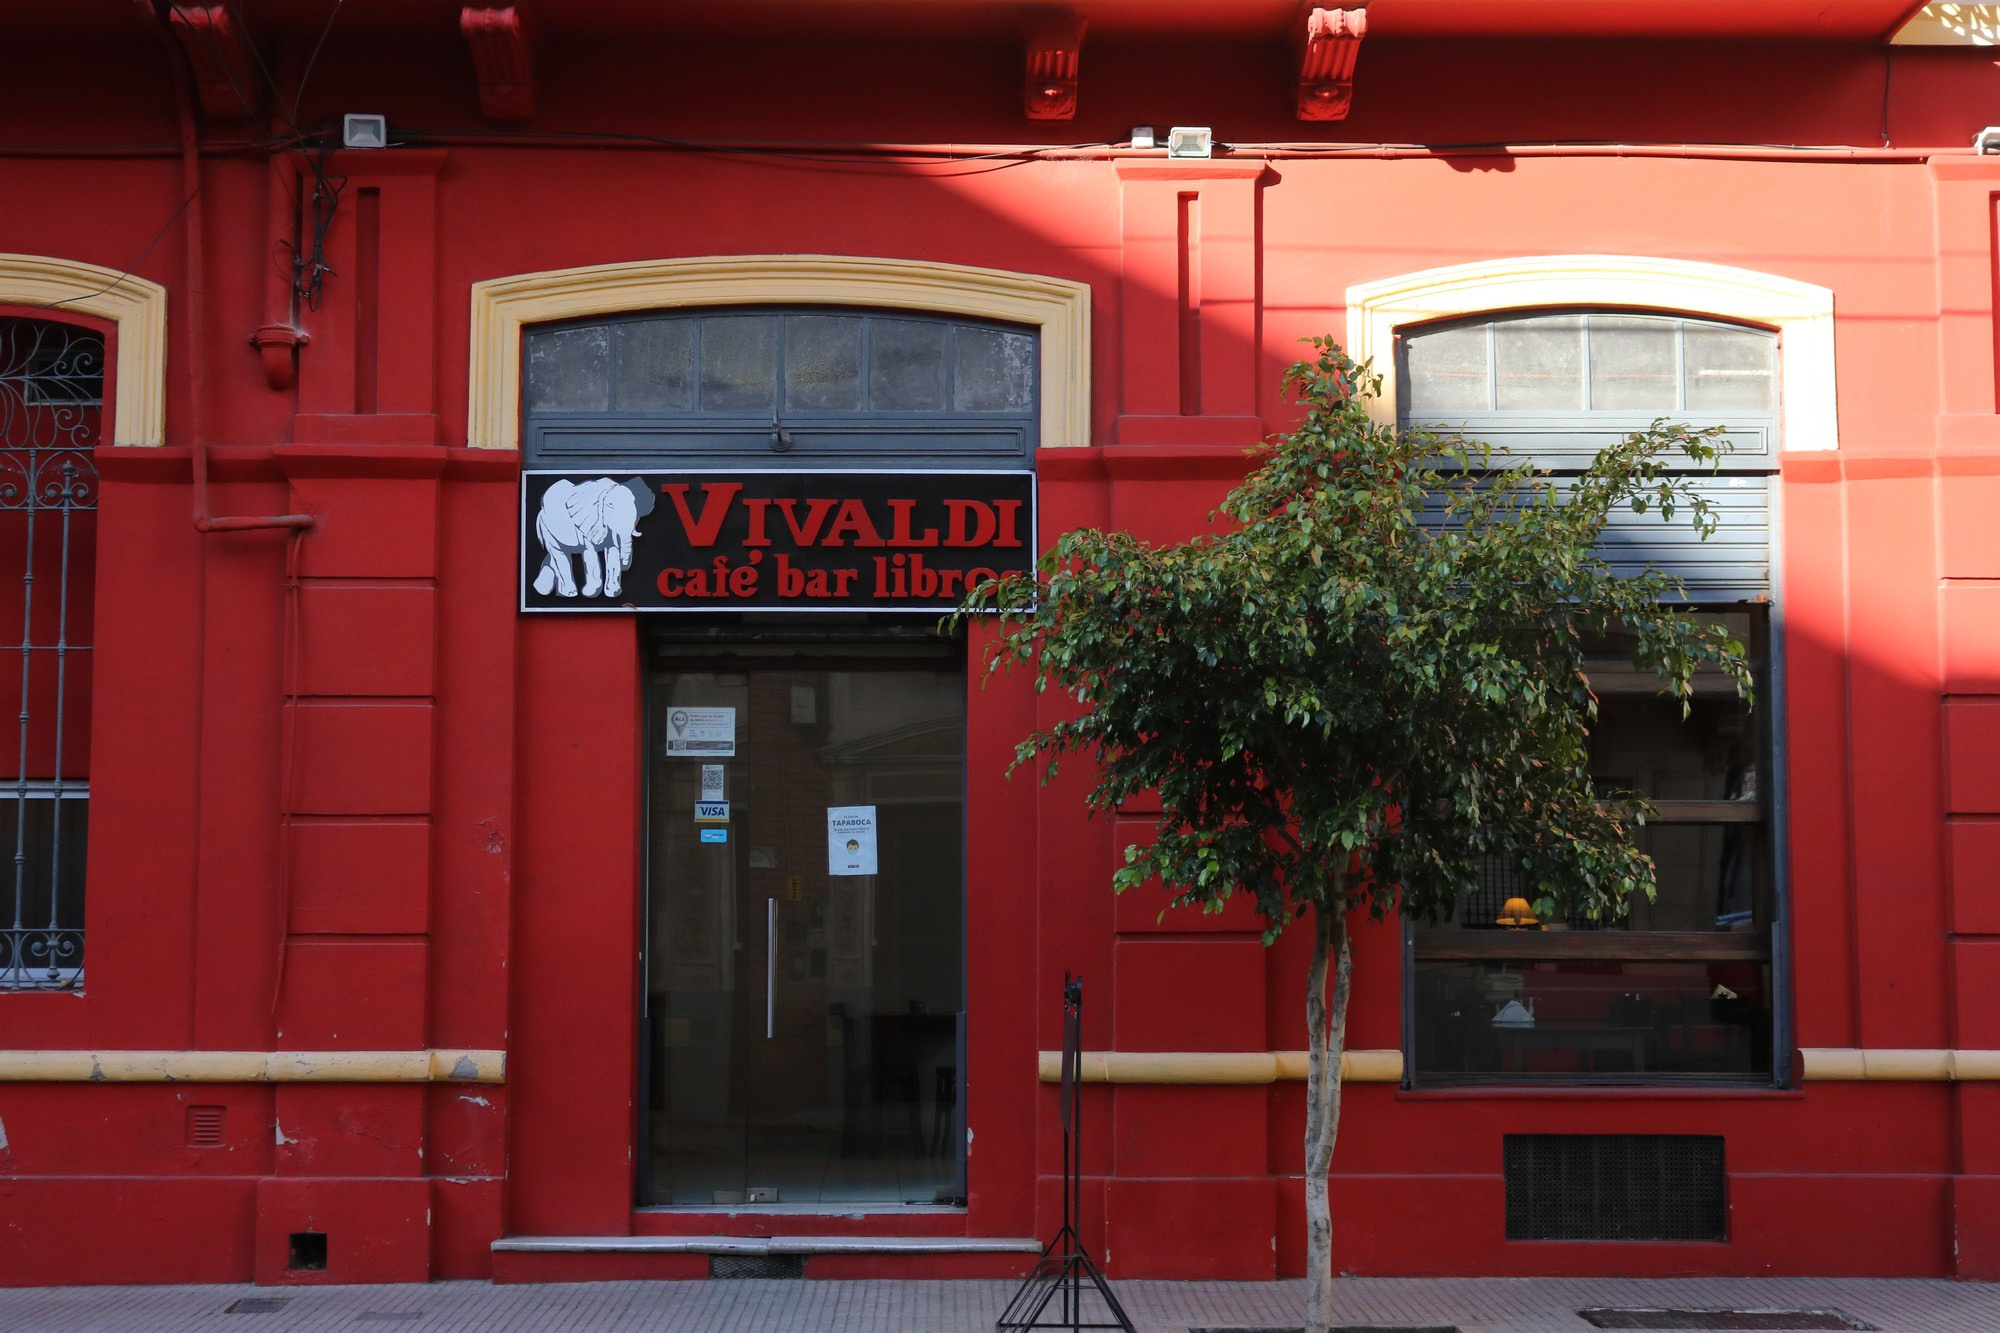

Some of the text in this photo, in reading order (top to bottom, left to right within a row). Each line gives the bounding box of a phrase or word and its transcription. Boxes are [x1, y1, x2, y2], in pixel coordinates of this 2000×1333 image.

[661, 482, 1022, 548] VIVALDI
[656, 549, 763, 598] café
[773, 553, 858, 598] bar
[700, 806, 725, 816] VISA
